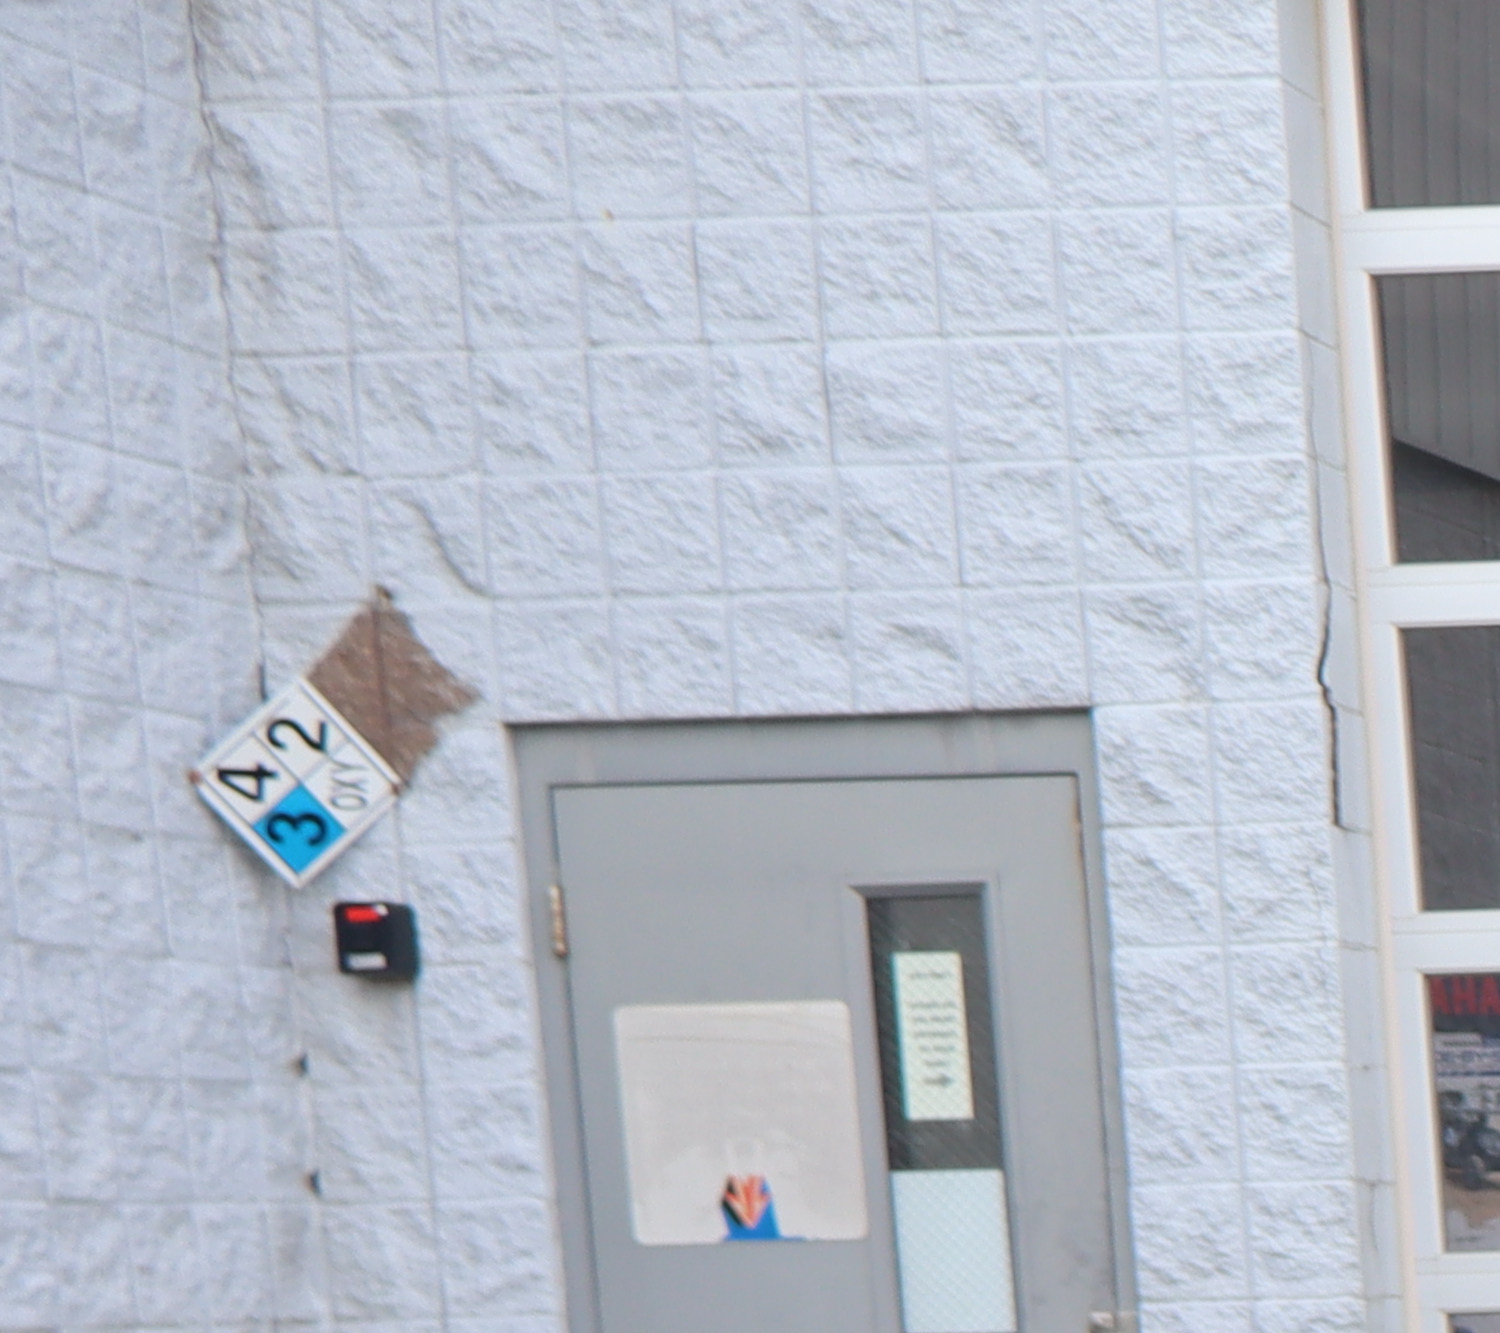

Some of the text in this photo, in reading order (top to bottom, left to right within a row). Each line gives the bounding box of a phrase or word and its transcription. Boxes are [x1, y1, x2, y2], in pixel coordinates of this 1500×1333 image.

[267, 719, 327, 753] 2
[216, 764, 279, 801] 4
[328, 752, 369, 811] OXY
[267, 812, 326, 846] 3
